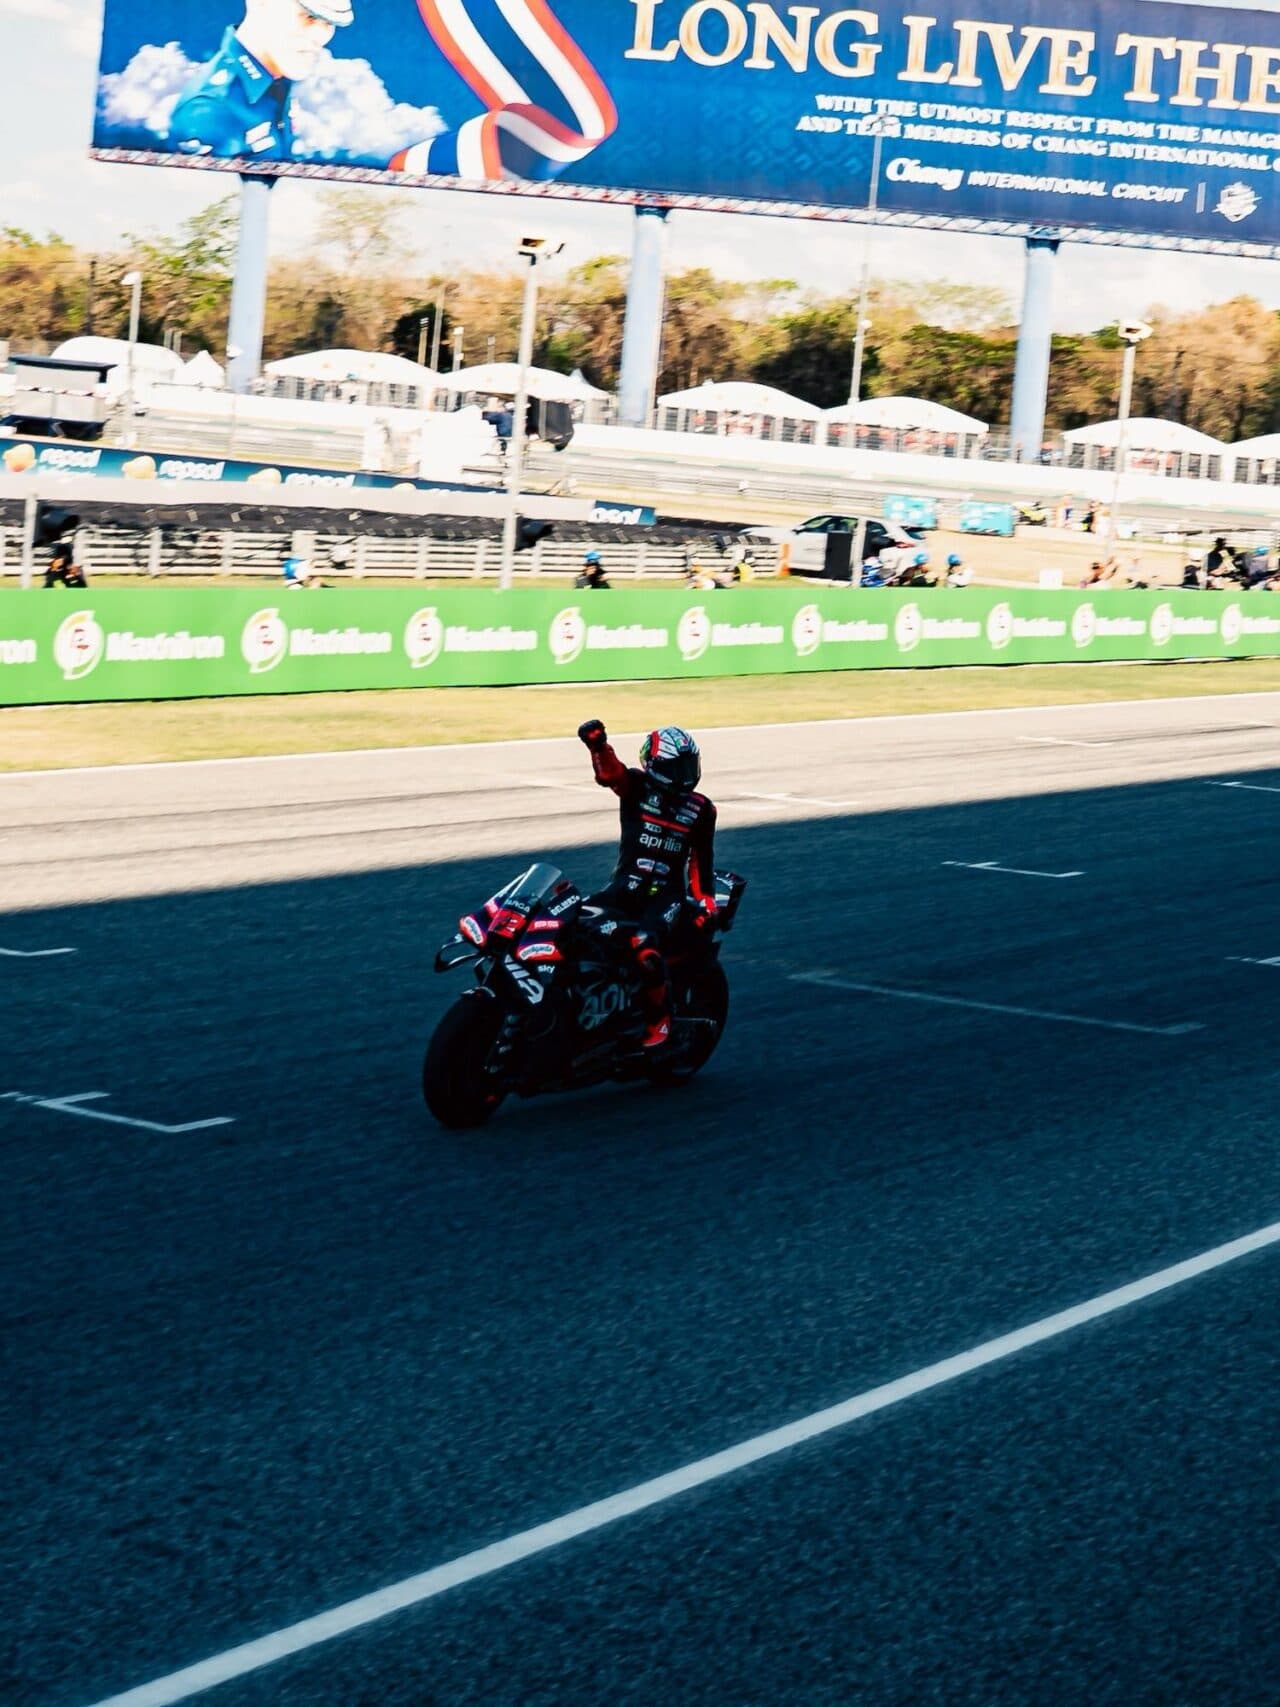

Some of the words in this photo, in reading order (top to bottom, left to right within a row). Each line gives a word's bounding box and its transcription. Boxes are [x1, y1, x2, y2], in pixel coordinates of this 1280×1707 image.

[624, 0, 882, 78] LONG
[897, 15, 1097, 97] LIVE
[815, 94, 873, 115] WITH
[873, 99, 918, 118] THE
[919, 102, 1006, 126] UTMOST
[1006, 110, 1095, 134] RESPECT
[1095, 117, 1157, 139] FROM
[1157, 123, 1201, 143] THE
[796, 115, 843, 134] AND
[902, 123, 1002, 147] MEMBERS
[1001, 133, 1033, 149] OF
[1032, 136, 1108, 157] CHANG
[1107, 142, 1273, 172] INTERNATIONAL
[885, 157, 965, 191] Chang
[1111, 182, 1190, 204] CIRCUIT
[639, 832, 683, 853] aprilia
